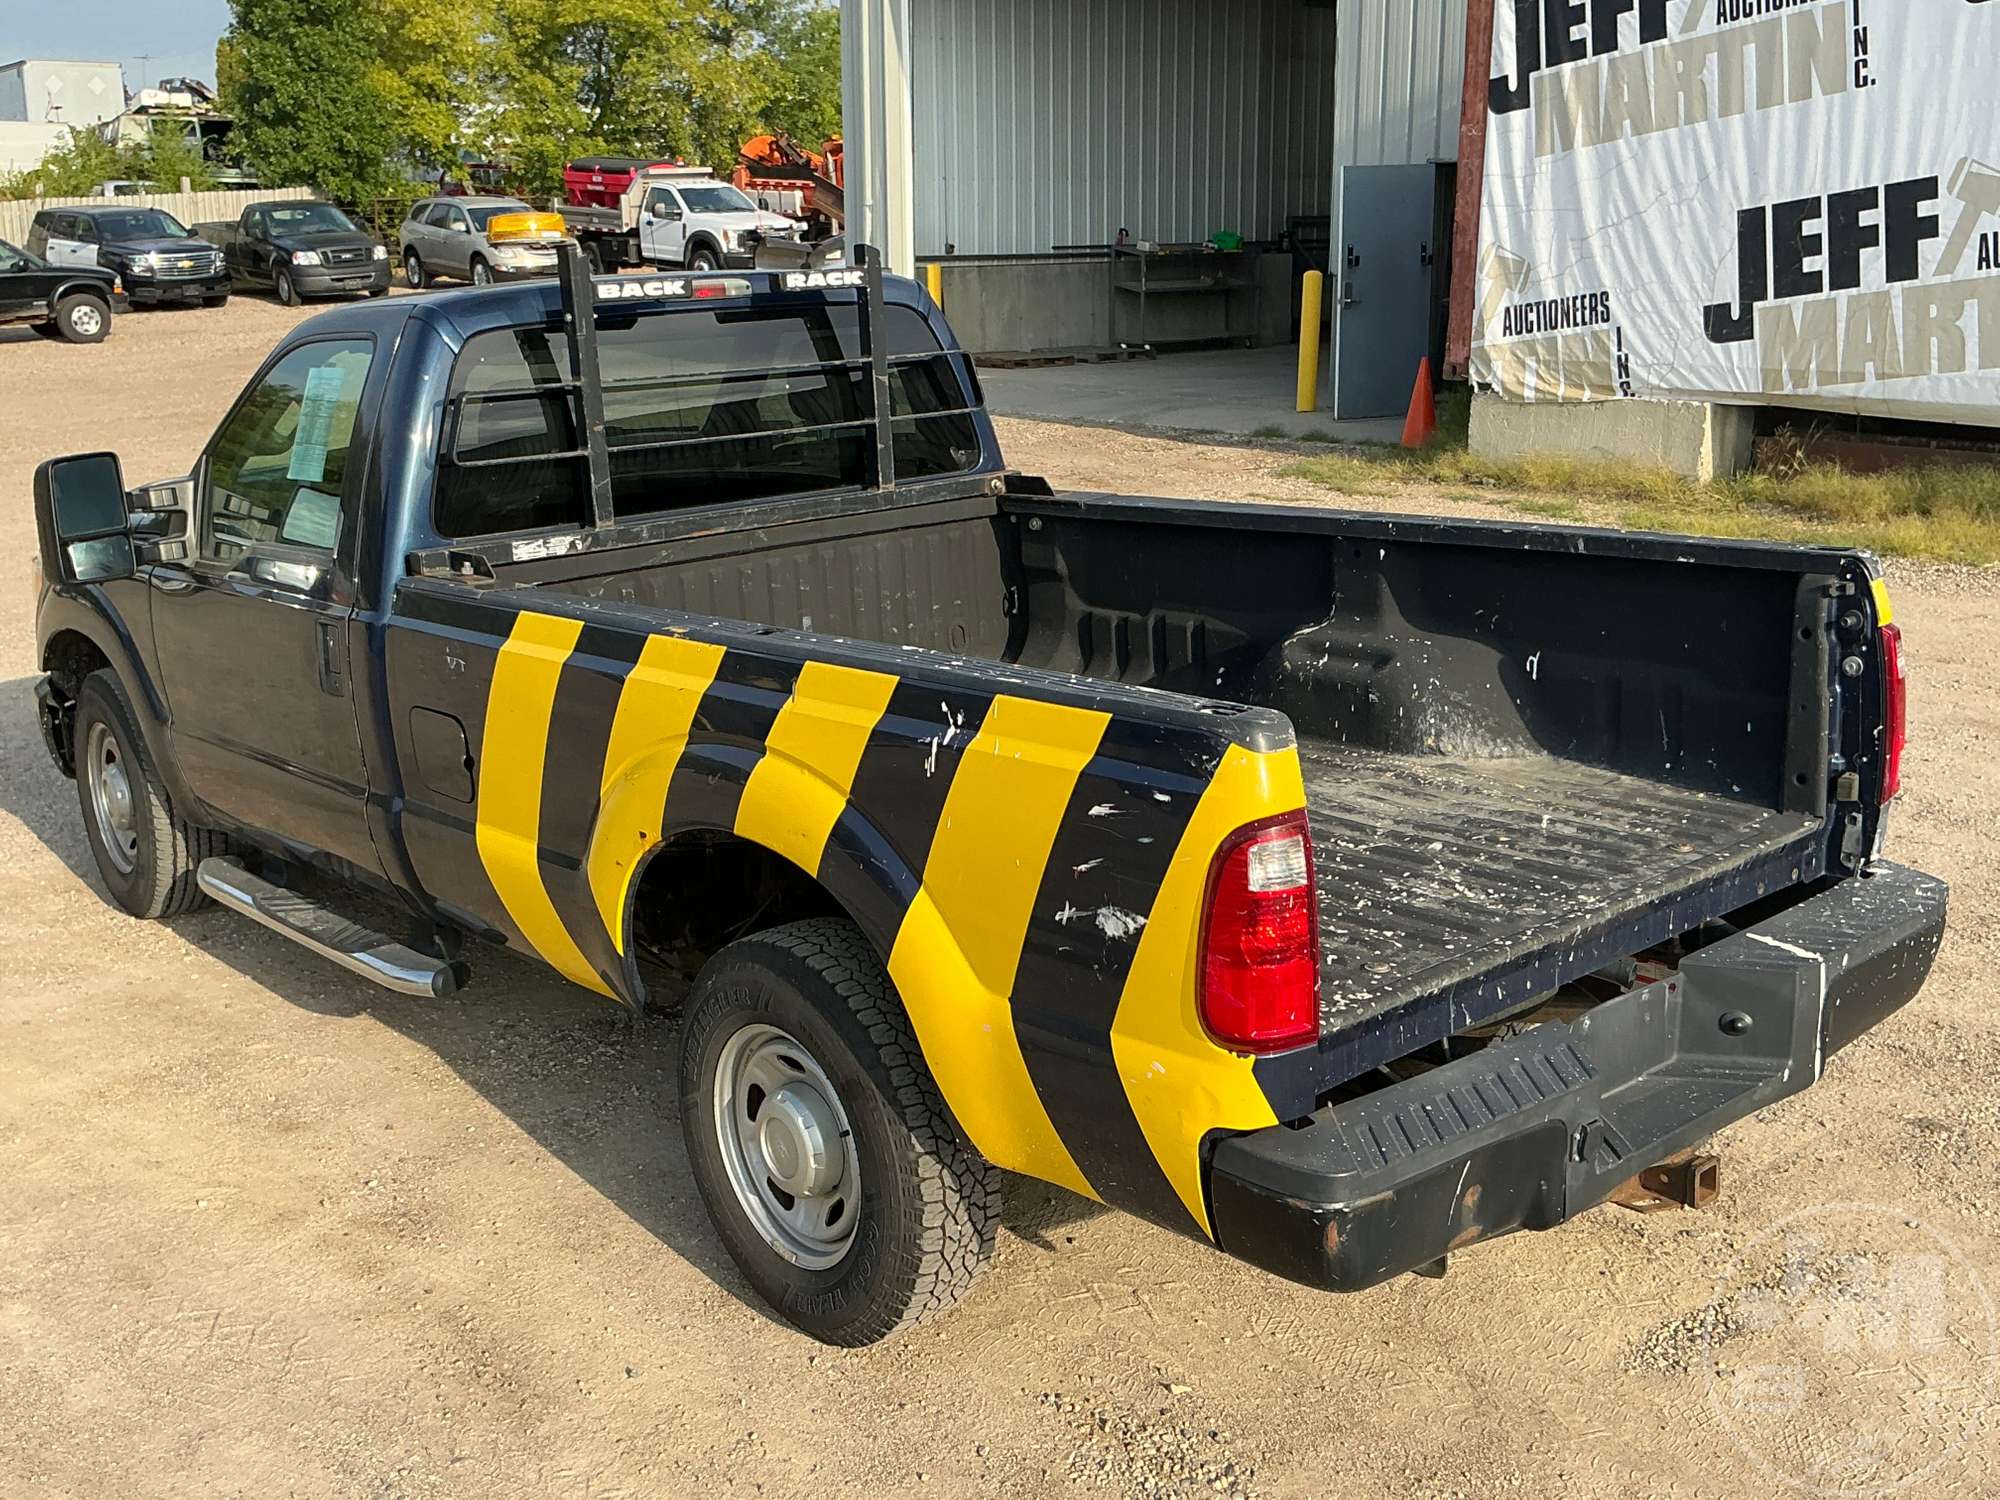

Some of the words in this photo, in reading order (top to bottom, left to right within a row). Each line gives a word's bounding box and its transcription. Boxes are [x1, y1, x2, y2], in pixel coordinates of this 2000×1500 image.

[1534, 3, 1847, 158] MARTIN
[599, 280, 686, 298] BACK
[786, 271, 864, 288] RACK
[1703, 175, 1940, 343] JEFF
[1502, 290, 1611, 337] AUCTIONEERS
